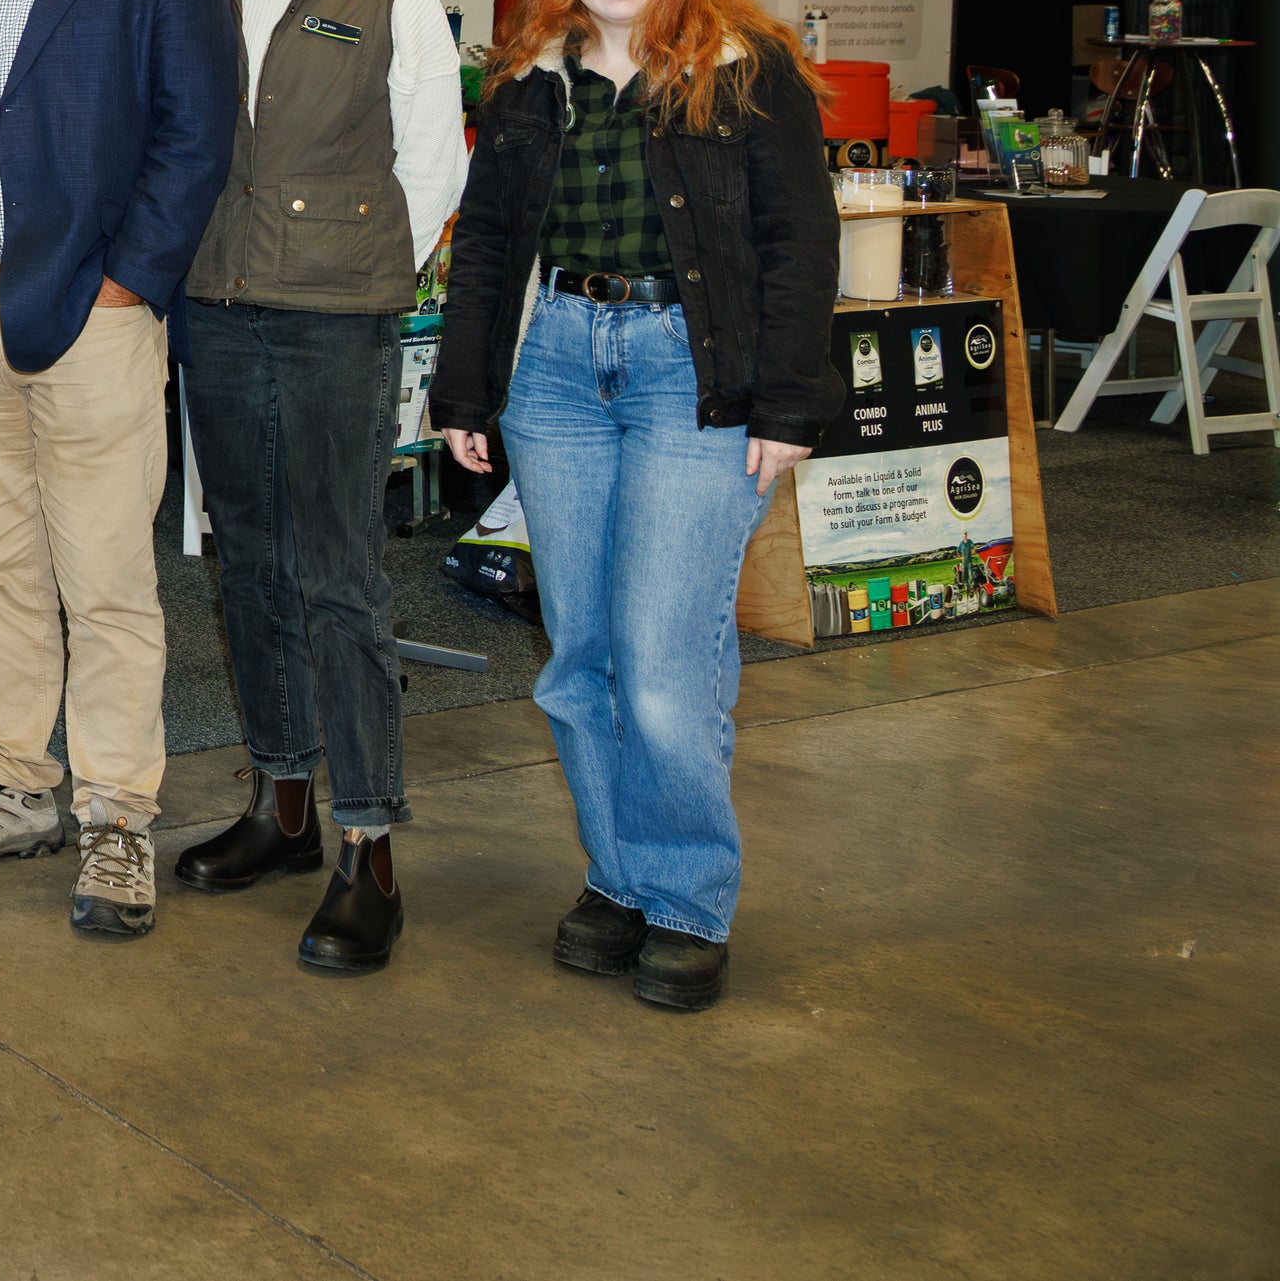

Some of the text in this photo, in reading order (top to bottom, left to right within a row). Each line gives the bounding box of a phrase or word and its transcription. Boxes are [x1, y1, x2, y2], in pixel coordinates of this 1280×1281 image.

[854, 406, 887, 421] COMBO
[915, 402, 948, 416] ANIMAL
[861, 424, 882, 437] PLUS
[923, 420, 943, 432] PLUS
[828, 467, 922, 487] Available in Liquid & Solid
[950, 482, 980, 494] AgriSea
